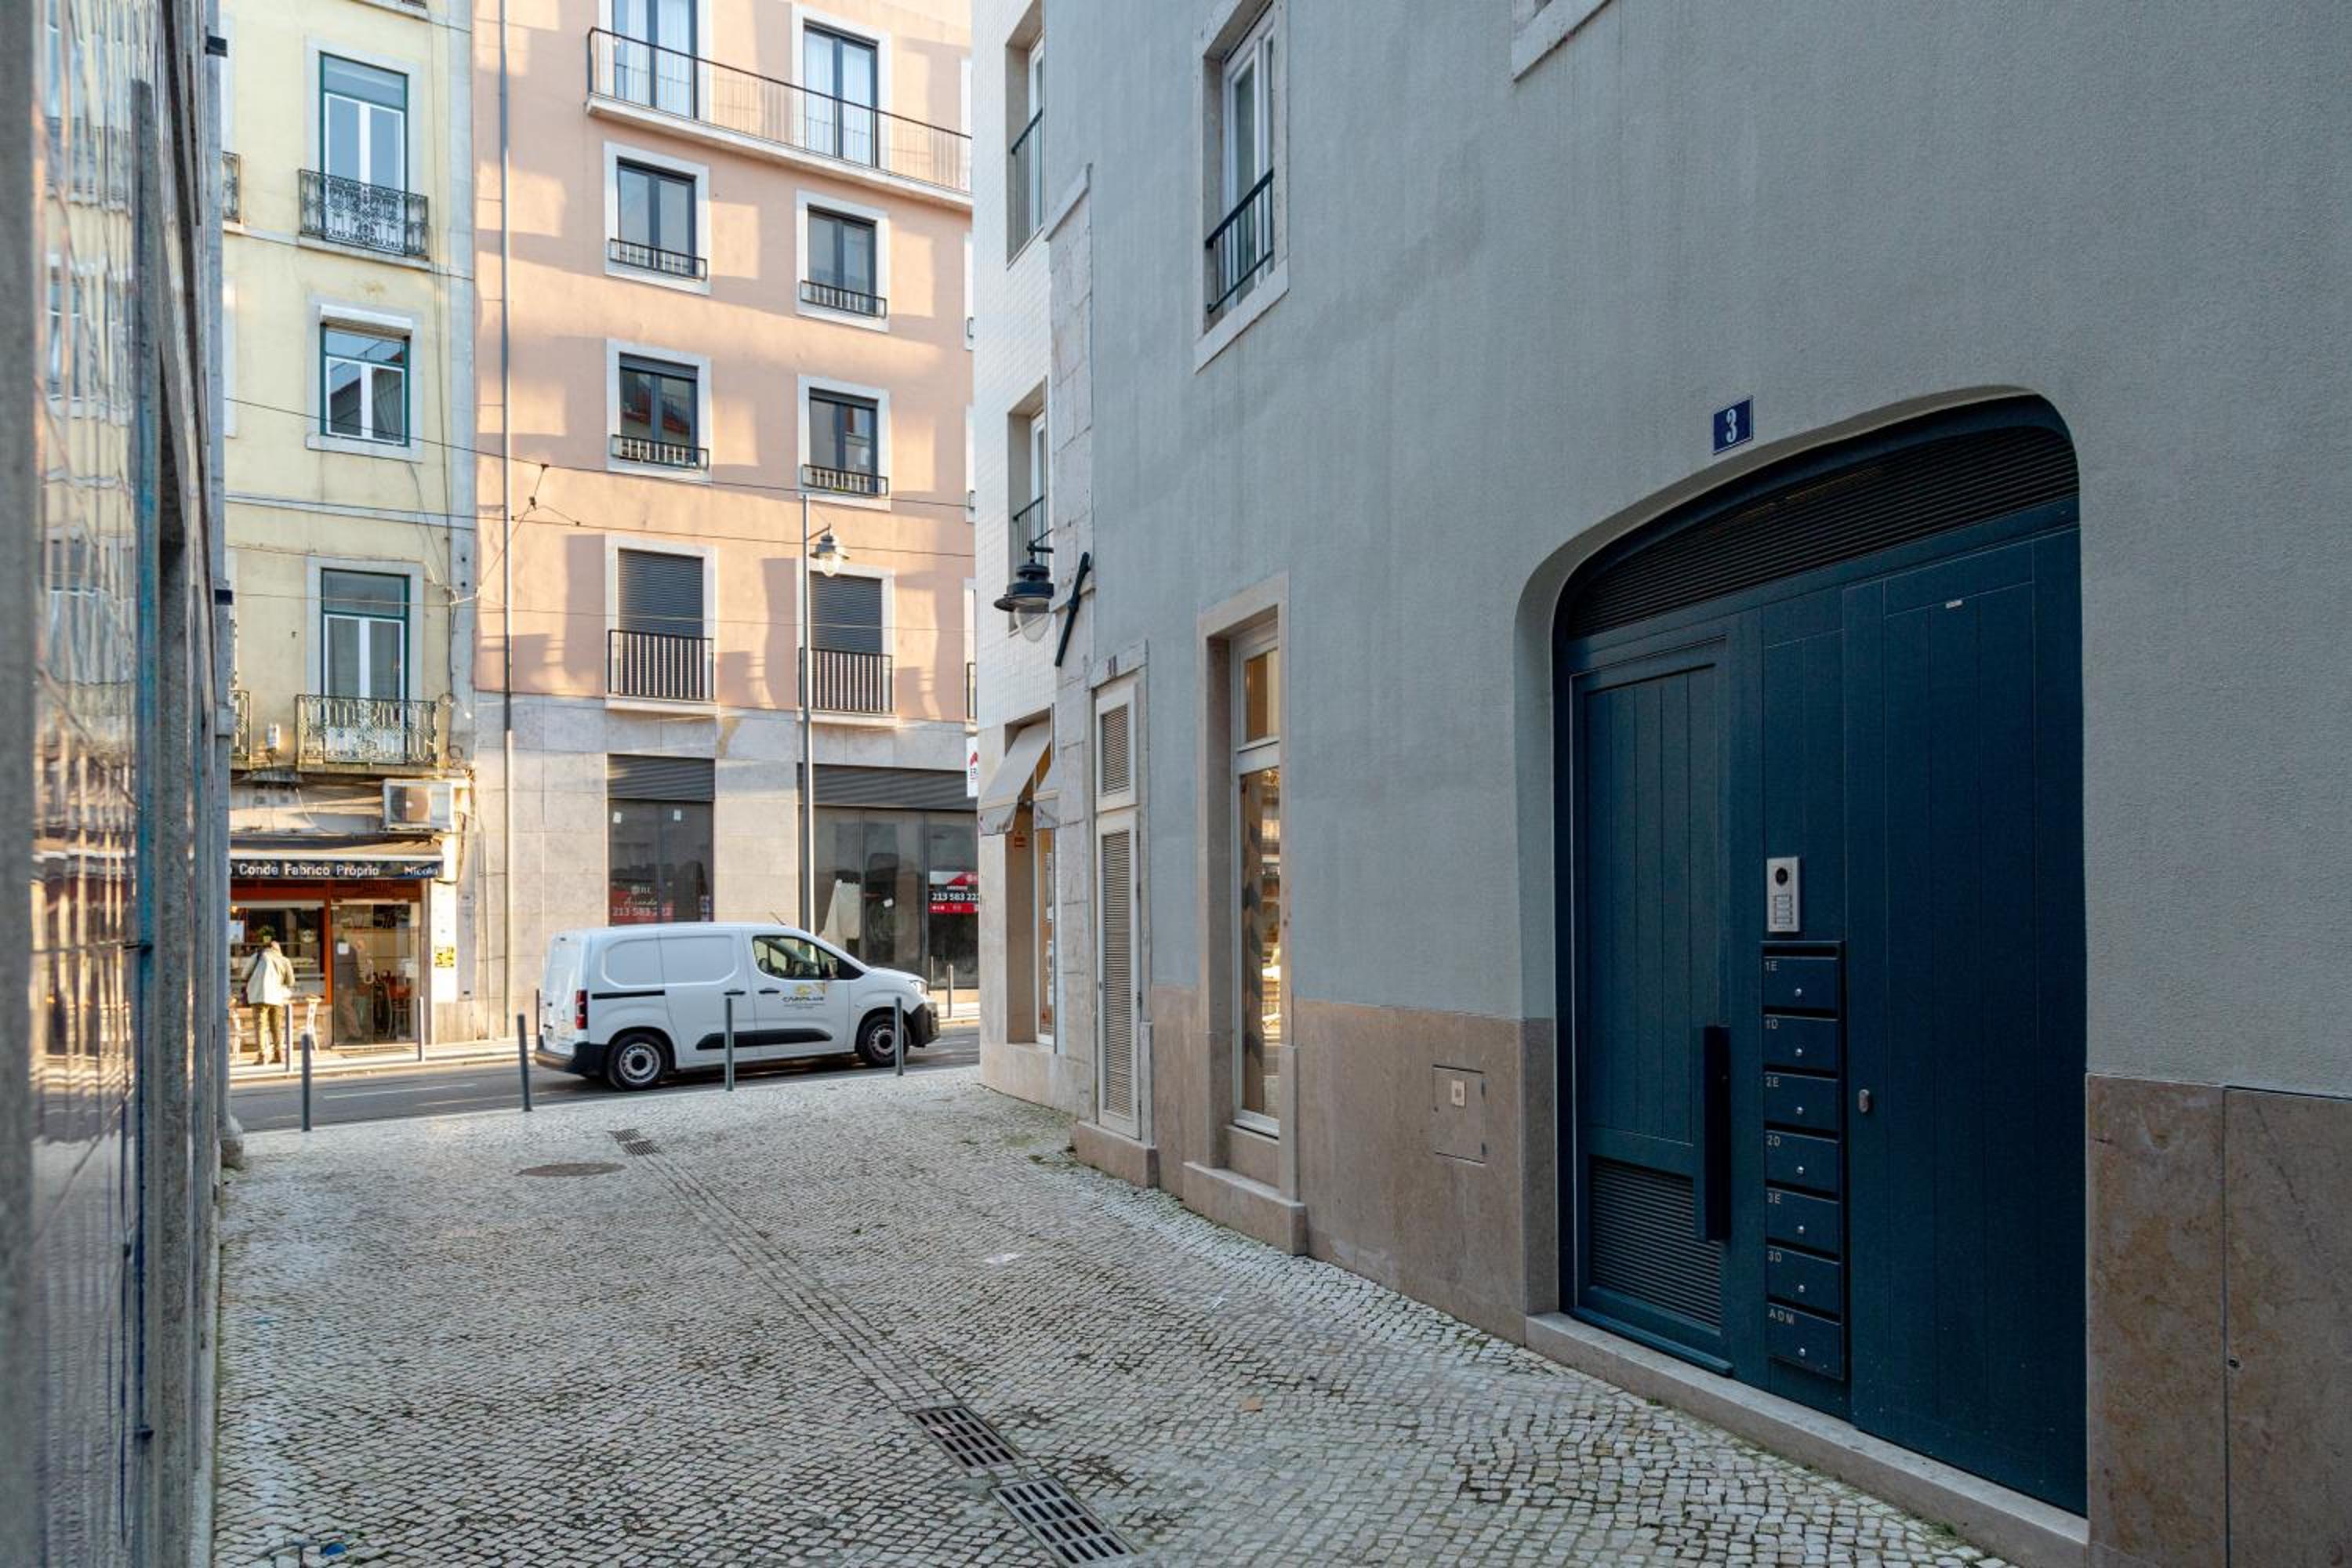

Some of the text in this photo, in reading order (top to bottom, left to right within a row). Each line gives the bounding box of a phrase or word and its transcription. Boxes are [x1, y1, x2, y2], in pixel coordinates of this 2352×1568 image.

[1726, 408, 1738, 443] 3
[239, 863, 278, 876] Conde
[285, 863, 330, 876] Fabrico
[336, 863, 379, 878] Próprio
[1765, 960, 1778, 971] 1E
[1766, 1018, 1779, 1029] 1D
[1766, 1076, 1780, 1087] 2E
[1767, 1134, 1780, 1147] 2D
[1768, 1192, 1781, 1204] 3E
[1768, 1250, 1782, 1263] 3D
[1769, 1308, 1795, 1325] ADM
